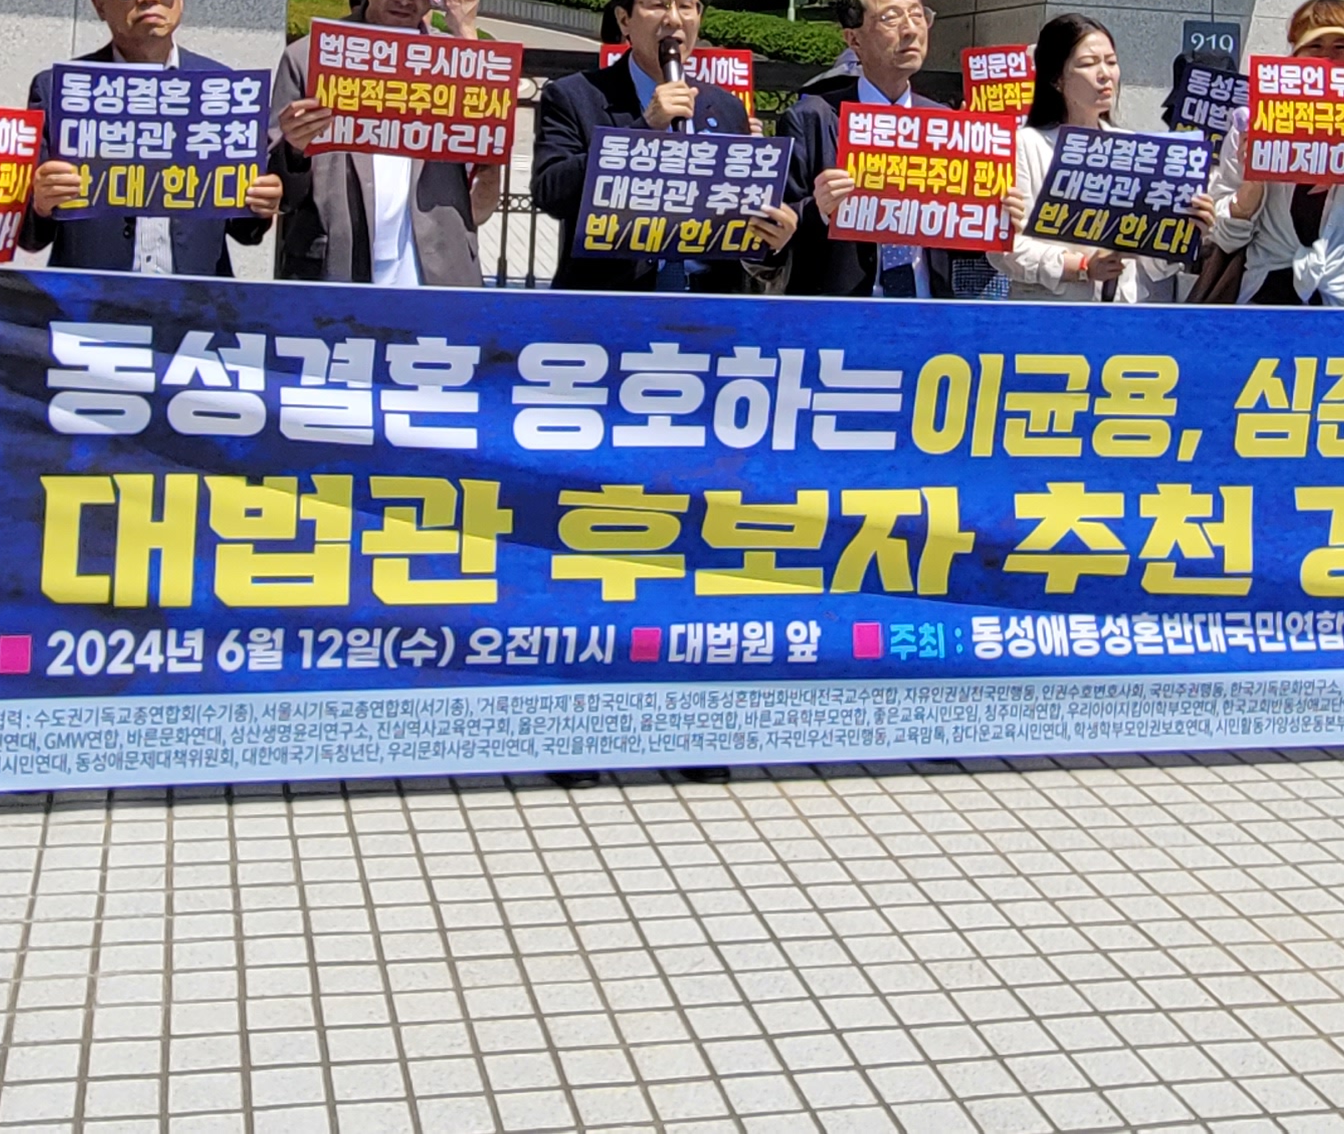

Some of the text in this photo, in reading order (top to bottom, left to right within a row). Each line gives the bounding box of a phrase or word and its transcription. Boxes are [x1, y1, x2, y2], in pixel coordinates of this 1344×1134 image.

[319, 32, 513, 81] 법문언 무시하는
[968, 52, 1026, 81] 법문언
[61, 73, 261, 116] 동성결혼 옹호
[315, 74, 511, 120] 사법적극주의 판사
[1257, 64, 1324, 96] 법문언
[59, 119, 258, 159] 대법관 추천
[599, 136, 781, 178] 동성결혼 옹호
[848, 112, 1011, 156] 법문언 무시하는
[1061, 133, 1160, 174] 동성결혼
[1163, 144, 1208, 179] 옹호
[593, 175, 774, 218] 대법관 추천
[847, 151, 1013, 198] 사법적극주의 판사
[1050, 169, 1203, 214] 대법관 추천
[836, 195, 1010, 241] 배제하라!
[1034, 201, 1196, 254] 반/대/한/다!
[47, 320, 481, 452] 동성결혼
[39, 473, 513, 608] 대법관
[549, 485, 976, 603] 후보자
[1002, 481, 1255, 597] 추천
[46, 628, 204, 677] 2024년
[216, 627, 284, 672] 6월
[298, 625, 456, 670] 12일(수)
[465, 624, 616, 665] 오전11시
[667, 620, 774, 664] 대법원
[785, 620, 821, 663] 앞
[889, 623, 946, 660] 주최
[32, 703, 258, 728] 수도권기독교총연합회(수기총),
[261, 696, 474, 721] 서울시기독교총연합회(서기총),
[476, 691, 662, 715] '거룩한방파제'통합국민대회,
[664, 687, 901, 710] 동성애동성혼합법화반대전국교수연합,
[902, 684, 1039, 704] 자유인권실천국민행동,
[1041, 683, 1146, 700] 인권수호변호사회,
[1148, 681, 1227, 699] 국민주권행동,
[1229, 678, 1342, 697] 한국기독문화연구소,
[43, 729, 123, 751] GMW연합,
[126, 726, 226, 748] 바른문화연대,
[230, 722, 373, 745] 성산생명윤리연구소,
[376, 718, 514, 740] 진실역사교육연구회,
[517, 713, 636, 735] 옳은가치시민연합,
[639, 711, 742, 731] 옳은학부모연합,
[744, 708, 870, 728] 바른교육학부모연합,
[872, 705, 981, 725] 좋은교육시민모임,
[984, 703, 1064, 722] 청주미래연합,
[1066, 700, 1219, 720] 우리아이지킴이학부모연대,
[75, 747, 239, 772] 동성애문제대책위원회,
[241, 743, 384, 766] 대한애국기독청년단,
[387, 738, 539, 761] 우리문화사랑국민연대,
[540, 734, 646, 756] 국민을위한대안,
[648, 731, 764, 752] 난민대책국민행동,
[765, 727, 890, 749] 자국민우선국민행동,
[951, 722, 1071, 743] 참다운교육시민연대,
[1073, 718, 1214, 740] 학생학부모인권보호연대,
